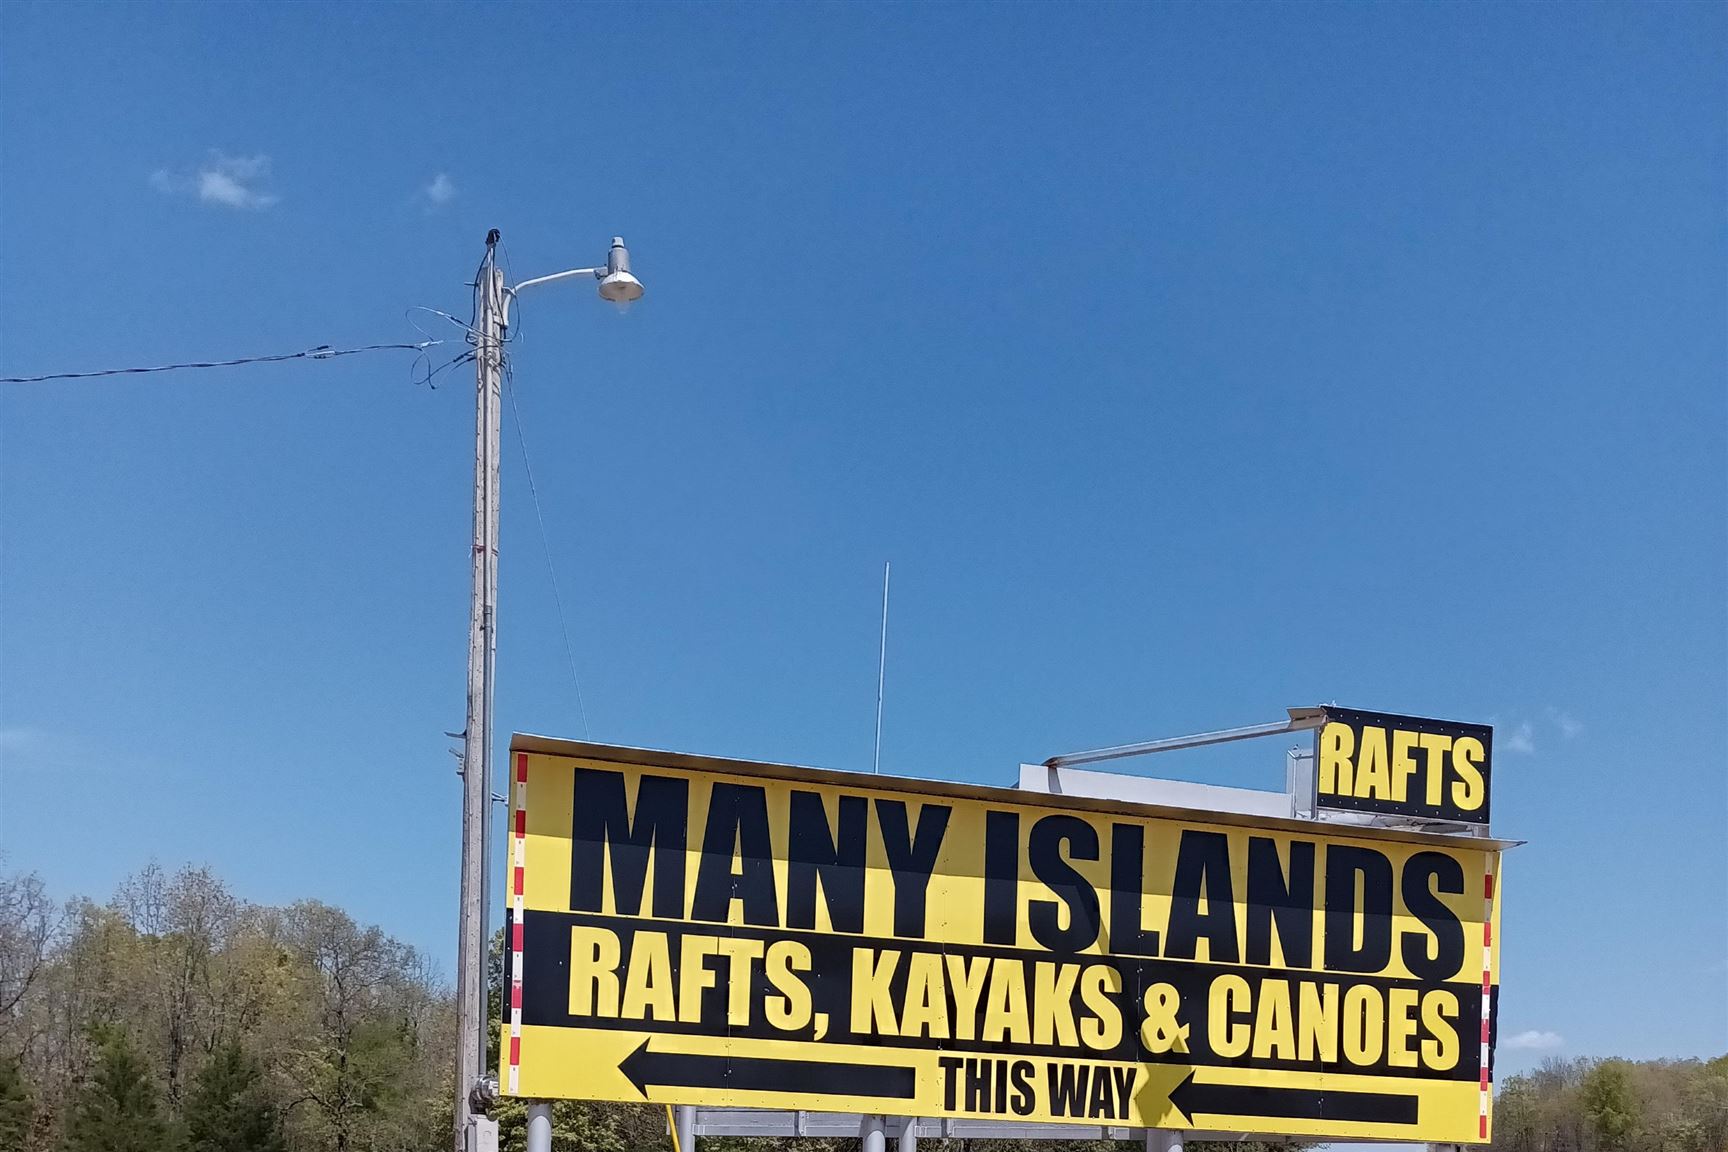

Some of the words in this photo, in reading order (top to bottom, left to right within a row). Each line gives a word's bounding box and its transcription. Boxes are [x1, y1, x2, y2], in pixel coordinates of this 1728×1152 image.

[1319, 722, 1485, 811] RAFTS
[569, 767, 952, 939] MANY
[983, 810, 1464, 981] ISLANDS
[568, 925, 829, 1041] RAFTS,
[850, 947, 1123, 1051] KAYAKS
[1141, 982, 1190, 1054] &
[1207, 974, 1460, 1071] CANOES
[938, 1057, 1036, 1117] THIS
[1047, 1063, 1137, 1120] WAY
